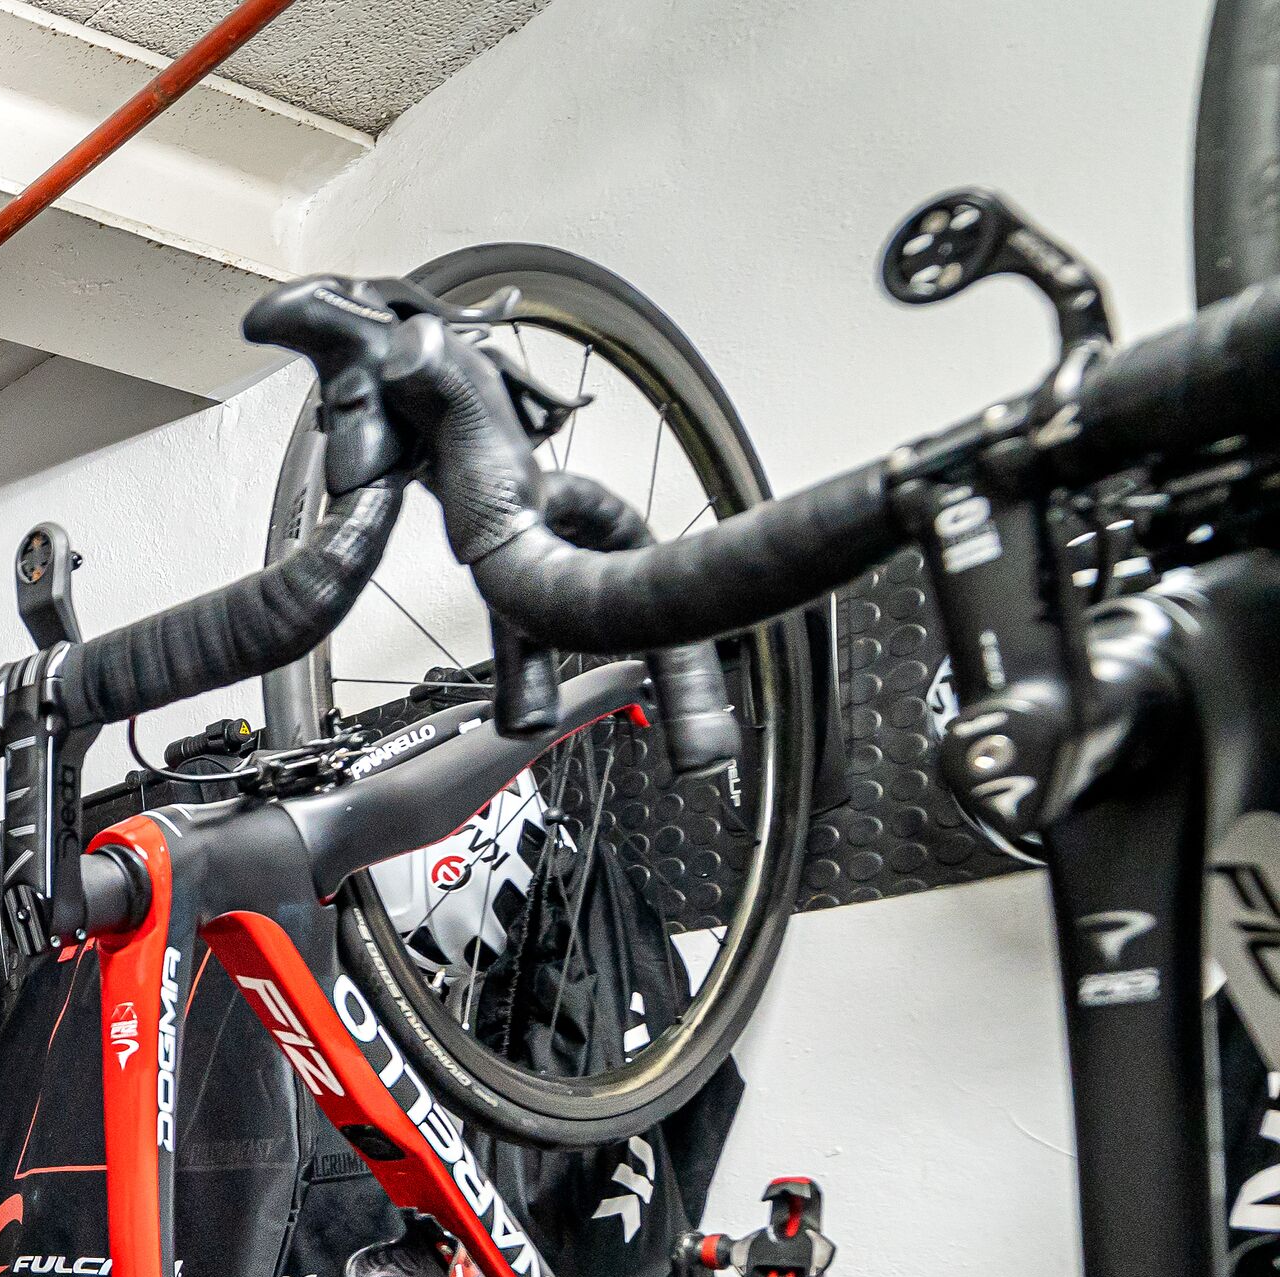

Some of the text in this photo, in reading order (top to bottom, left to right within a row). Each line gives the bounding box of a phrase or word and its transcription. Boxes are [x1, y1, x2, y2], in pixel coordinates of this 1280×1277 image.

[396, 998, 431, 1042] PRIX
[157, 947, 182, 1154] DOGMA
[423, 1039, 473, 1087] GRAND
